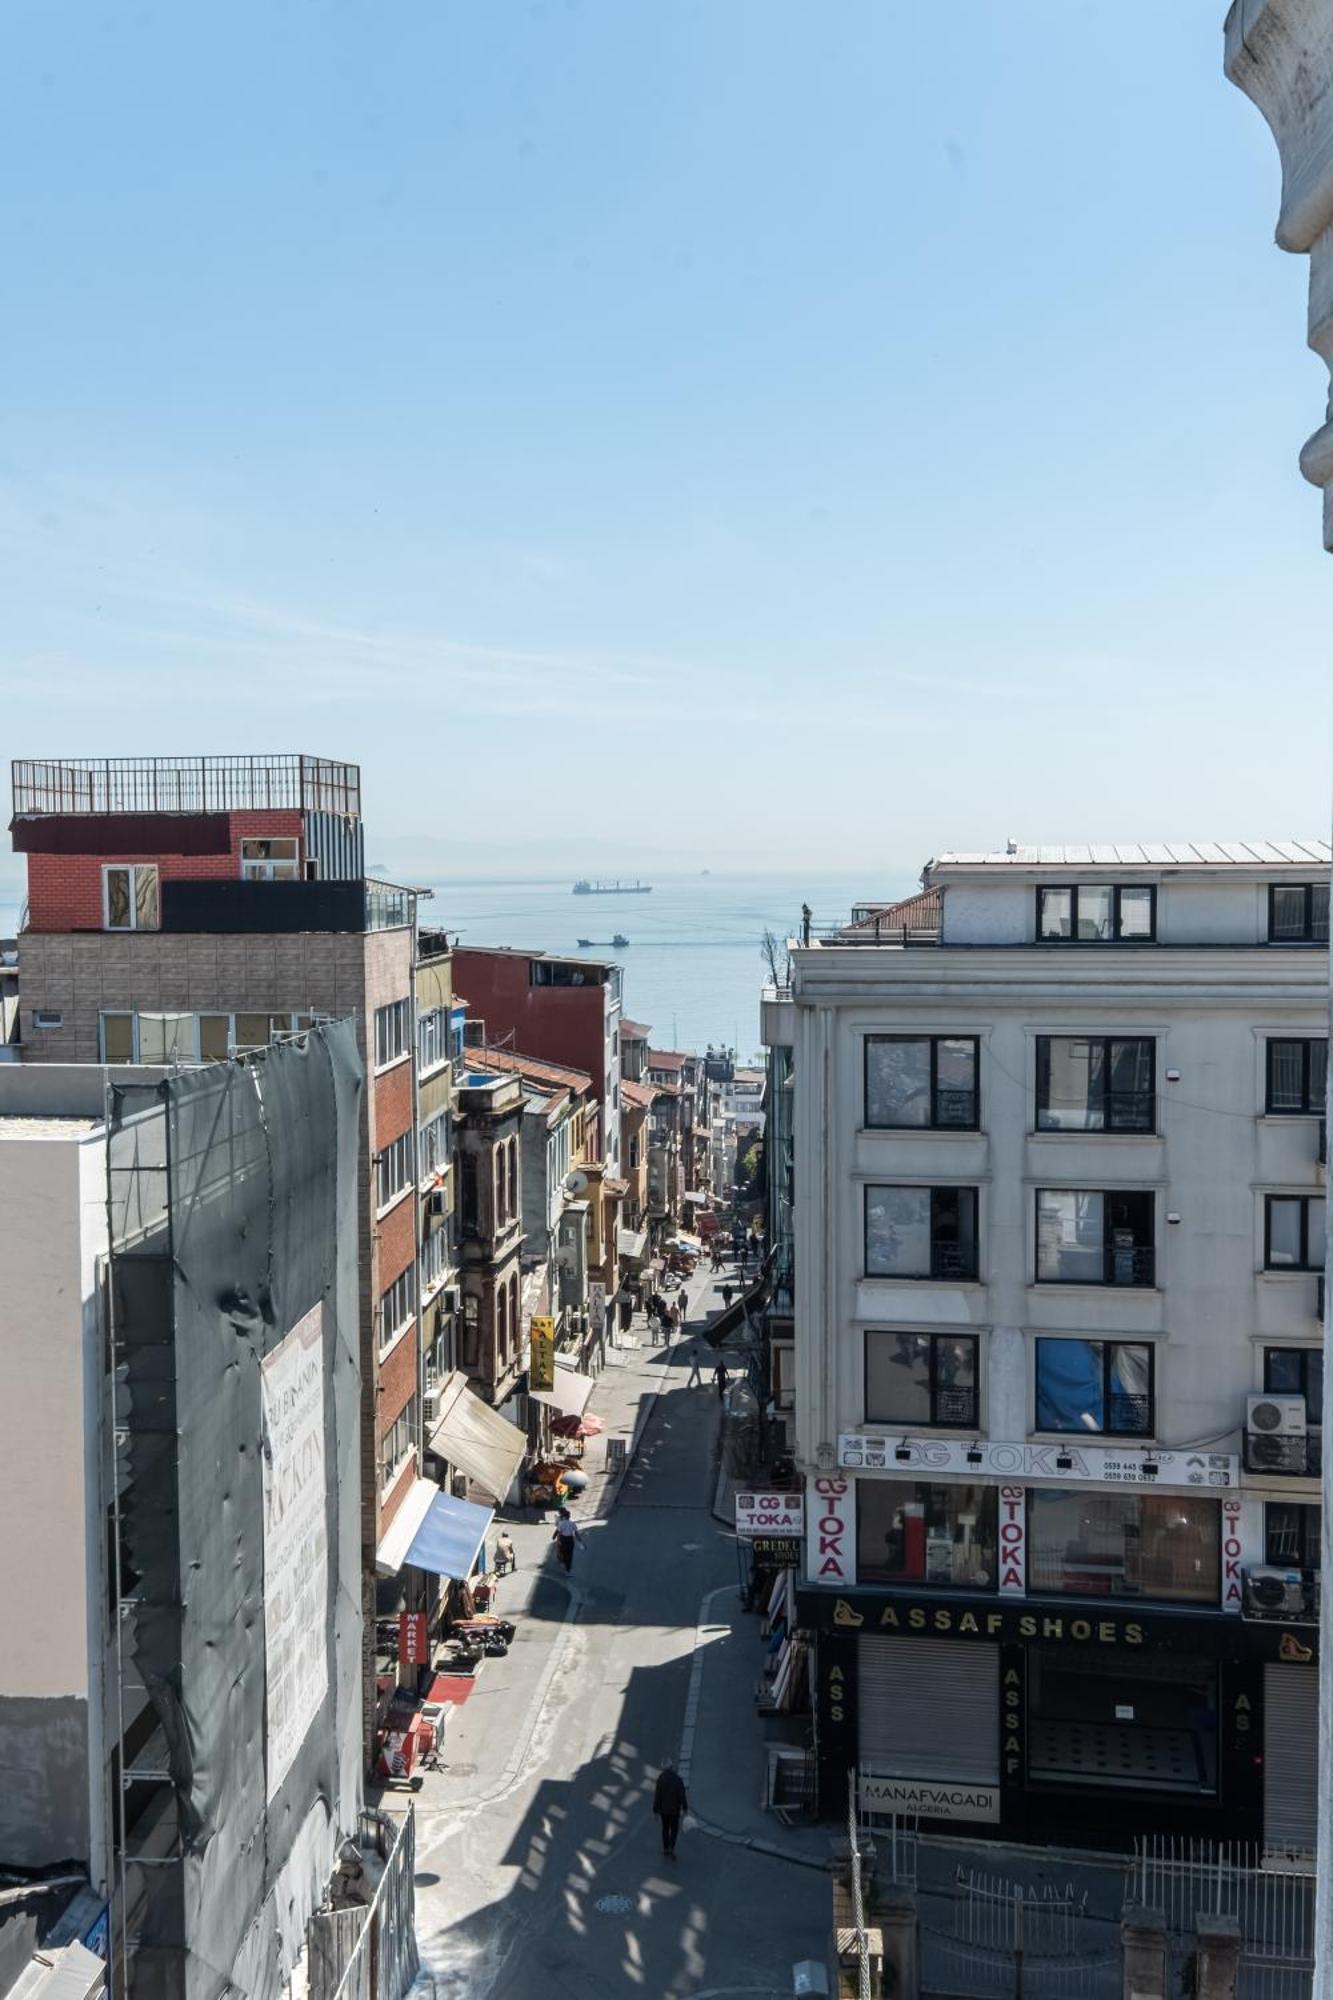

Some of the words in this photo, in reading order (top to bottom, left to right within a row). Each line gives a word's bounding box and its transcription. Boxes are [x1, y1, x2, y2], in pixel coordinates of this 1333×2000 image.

[747, 1514, 793, 1526] TOKA
[818, 1496, 845, 1577] TOKA
[1001, 1501, 1023, 1587] TOKA
[1225, 1516, 1242, 1602] TOKA
[406, 1613, 419, 1664] MARKET
[880, 1606, 1004, 1634] ASSAF
[1018, 1615, 1144, 1644] SHOES
[829, 1665, 844, 1722] ASS
[1004, 1668, 1020, 1775] ASSAF
[905, 1803, 951, 1815] ALGERIA
